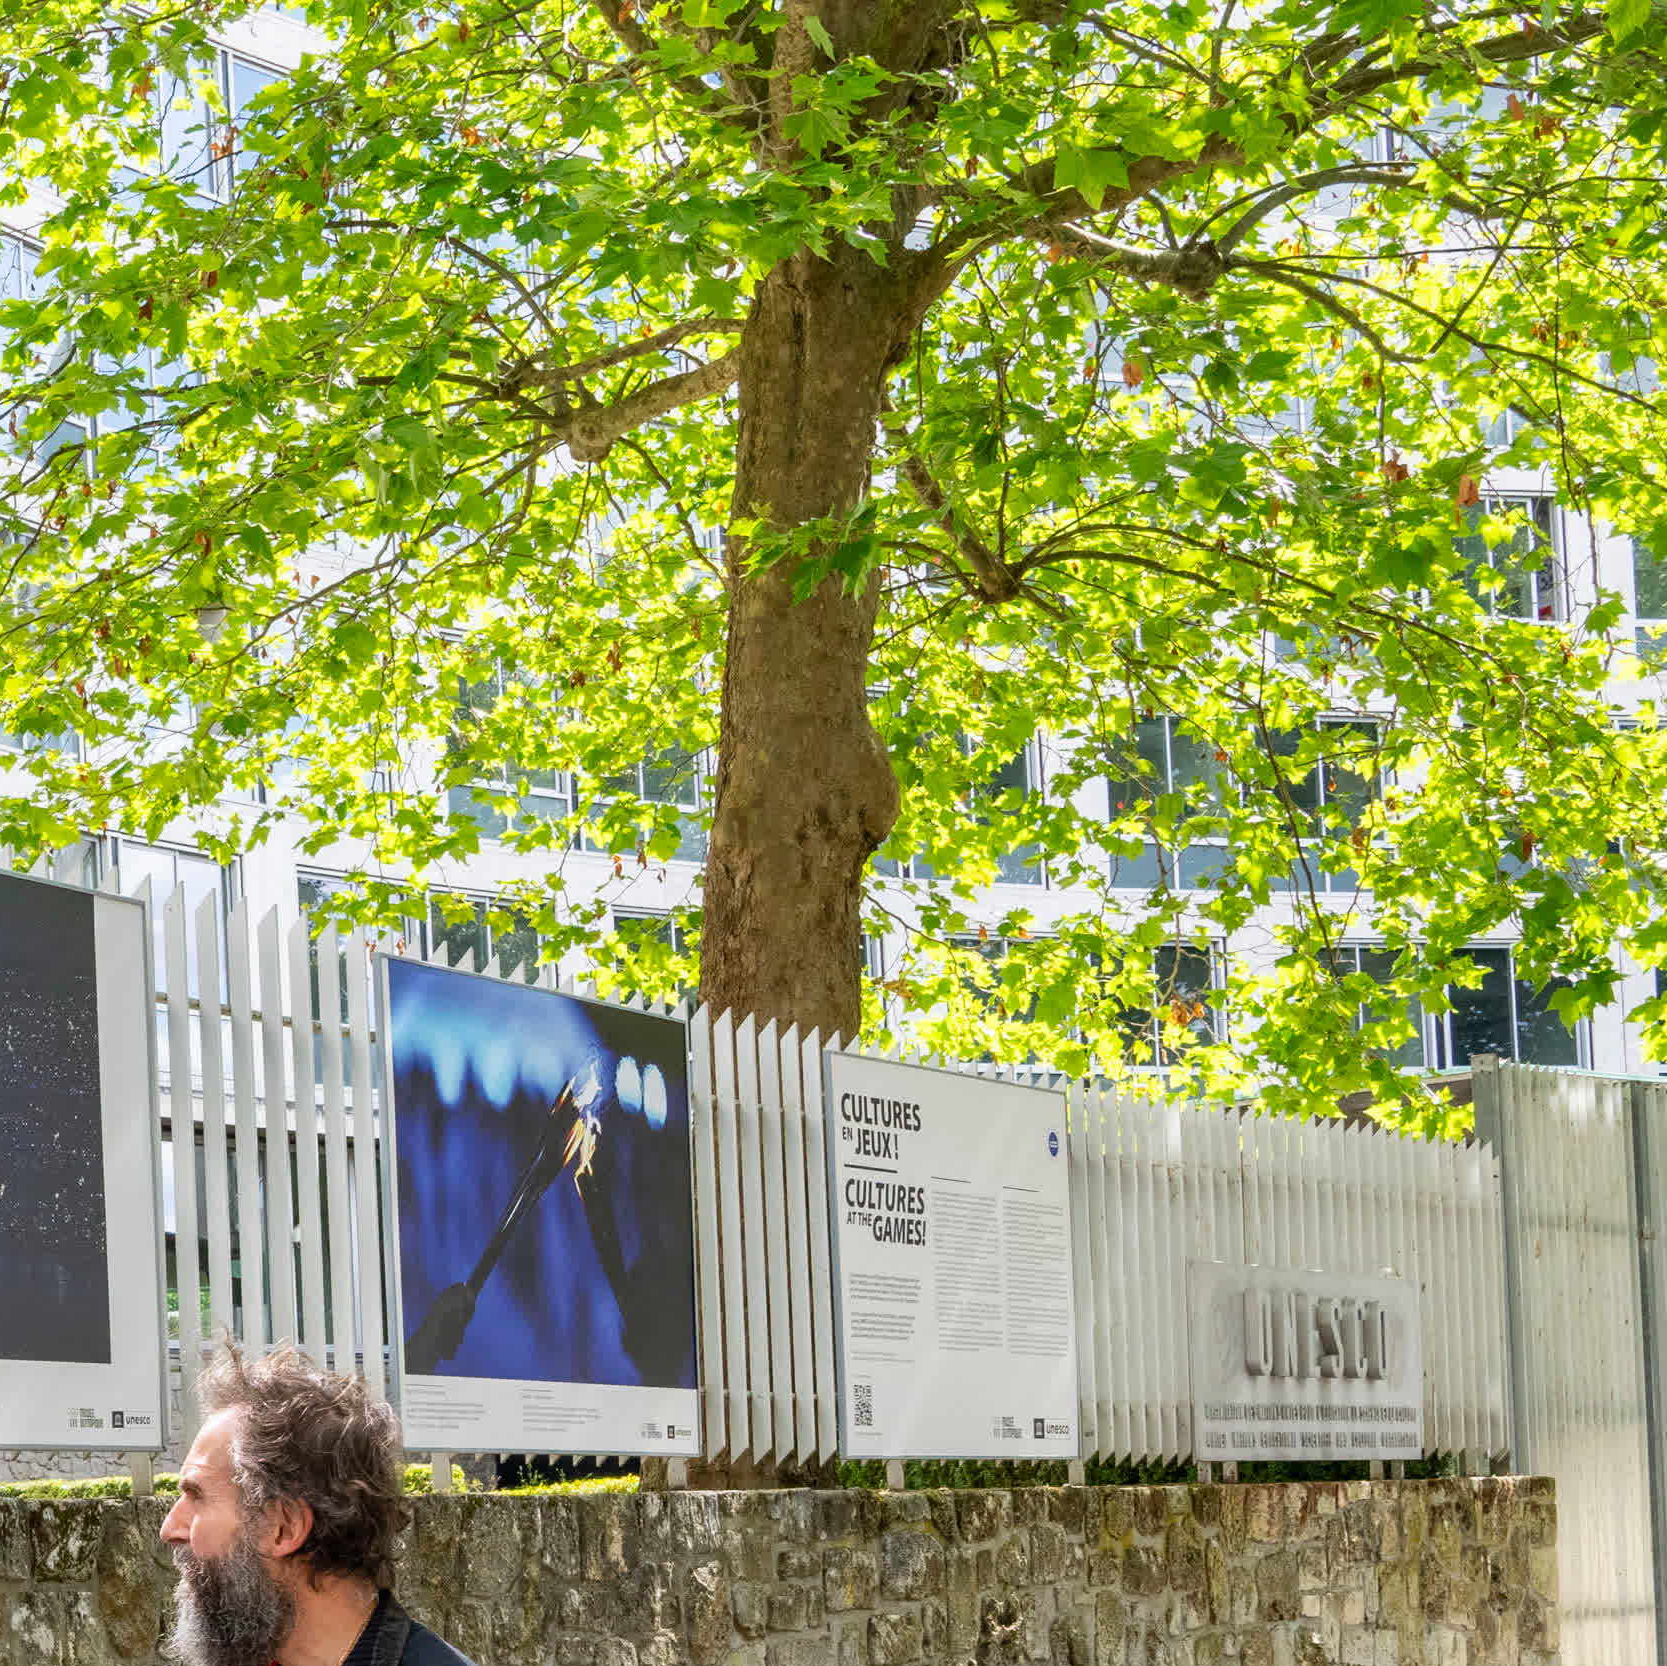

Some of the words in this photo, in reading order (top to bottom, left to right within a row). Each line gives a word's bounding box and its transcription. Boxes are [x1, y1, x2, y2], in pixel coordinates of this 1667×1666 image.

[841, 1092, 922, 1132] CULTURES
[842, 1126, 853, 1141] EN
[855, 1127, 891, 1159] JEUX
[845, 1178, 925, 1215] CULTURES
[846, 1211, 857, 1225] AT
[857, 1212, 872, 1227] THE
[872, 1215, 927, 1246] GAMES!
[125, 1415, 151, 1425] unesco
